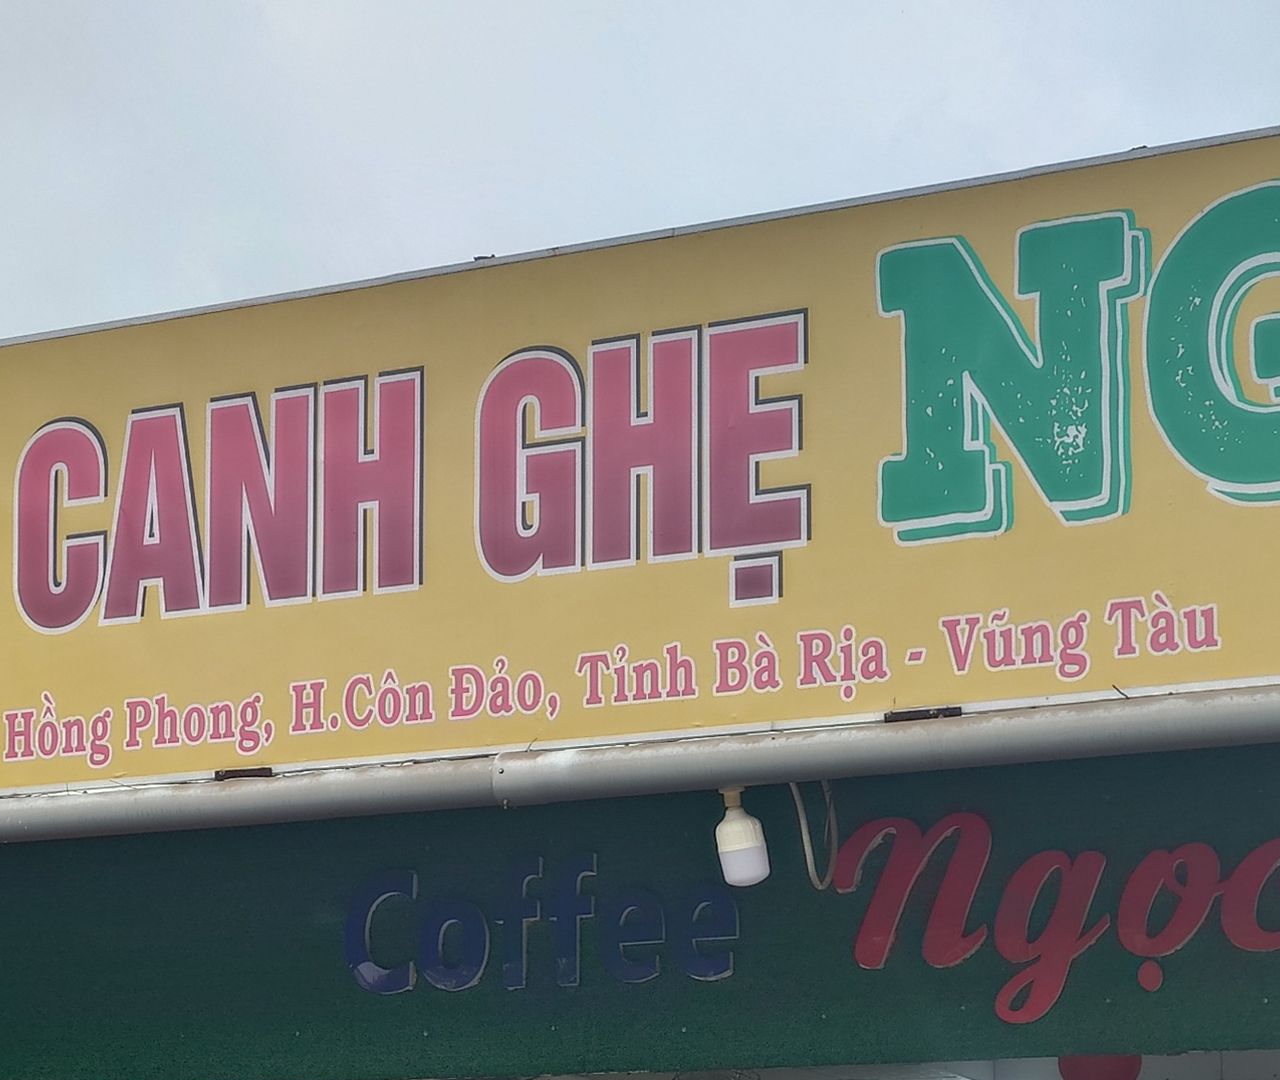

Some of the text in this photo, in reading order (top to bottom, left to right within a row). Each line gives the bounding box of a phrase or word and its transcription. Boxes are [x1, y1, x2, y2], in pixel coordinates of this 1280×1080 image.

[14, 365, 424, 636] CANH
[474, 308, 812, 609] GHẸ
[3, 690, 112, 768] Hồng
[123, 692, 275, 755] Phong,
[289, 667, 434, 736] H.Côn
[450, 654, 562, 722] Đảo,
[576, 643, 698, 706] Tỉnh
[714, 634, 782, 695] Bà
[797, 628, 890, 702] Rịa
[906, 646, 926, 668] -
[938, 606, 1091, 680] Vũng
[1106, 591, 1221, 654] Tàu
[345, 853, 741, 994] Coffee
